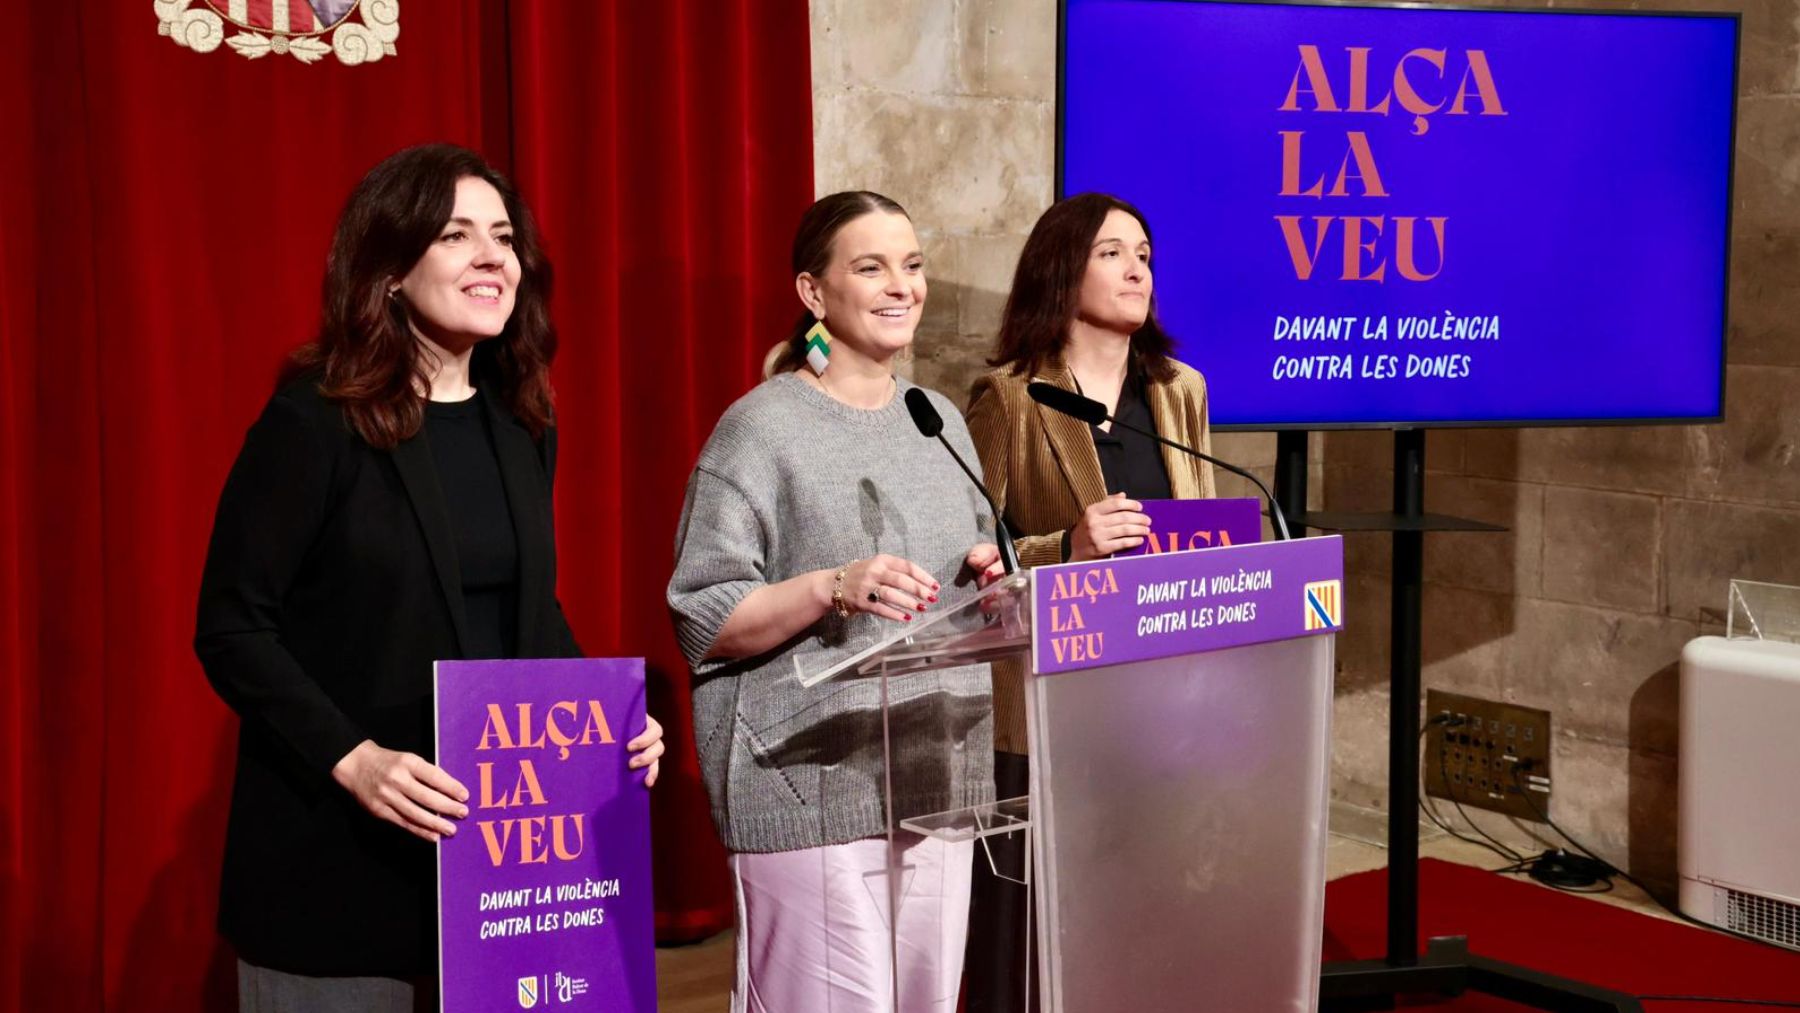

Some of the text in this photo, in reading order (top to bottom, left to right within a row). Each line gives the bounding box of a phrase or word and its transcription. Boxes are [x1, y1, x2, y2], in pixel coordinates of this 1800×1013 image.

[1277, 44, 1509, 136] ALÇA
[1277, 130, 1391, 200] LA
[1273, 214, 1449, 284] VEU
[1273, 309, 1500, 341] DAVANT LA VIOLÈNCIA
[1272, 353, 1472, 381] CONTRA LES DONES
[1050, 567, 1120, 604] ALÇA
[1137, 568, 1272, 606] DAVANT LA VIOLÈNCIA
[1050, 603, 1086, 633] LA
[1137, 602, 1257, 637] CONTRA LES DONES
[1050, 632, 1104, 665] VEU
[475, 699, 617, 761] ALÇA
[476, 758, 549, 810] LA
[476, 812, 585, 867] VEU
[480, 877, 620, 911] DAVANT LA VIOLÈNCIA
[480, 907, 604, 940] CONTRA LES DONES
